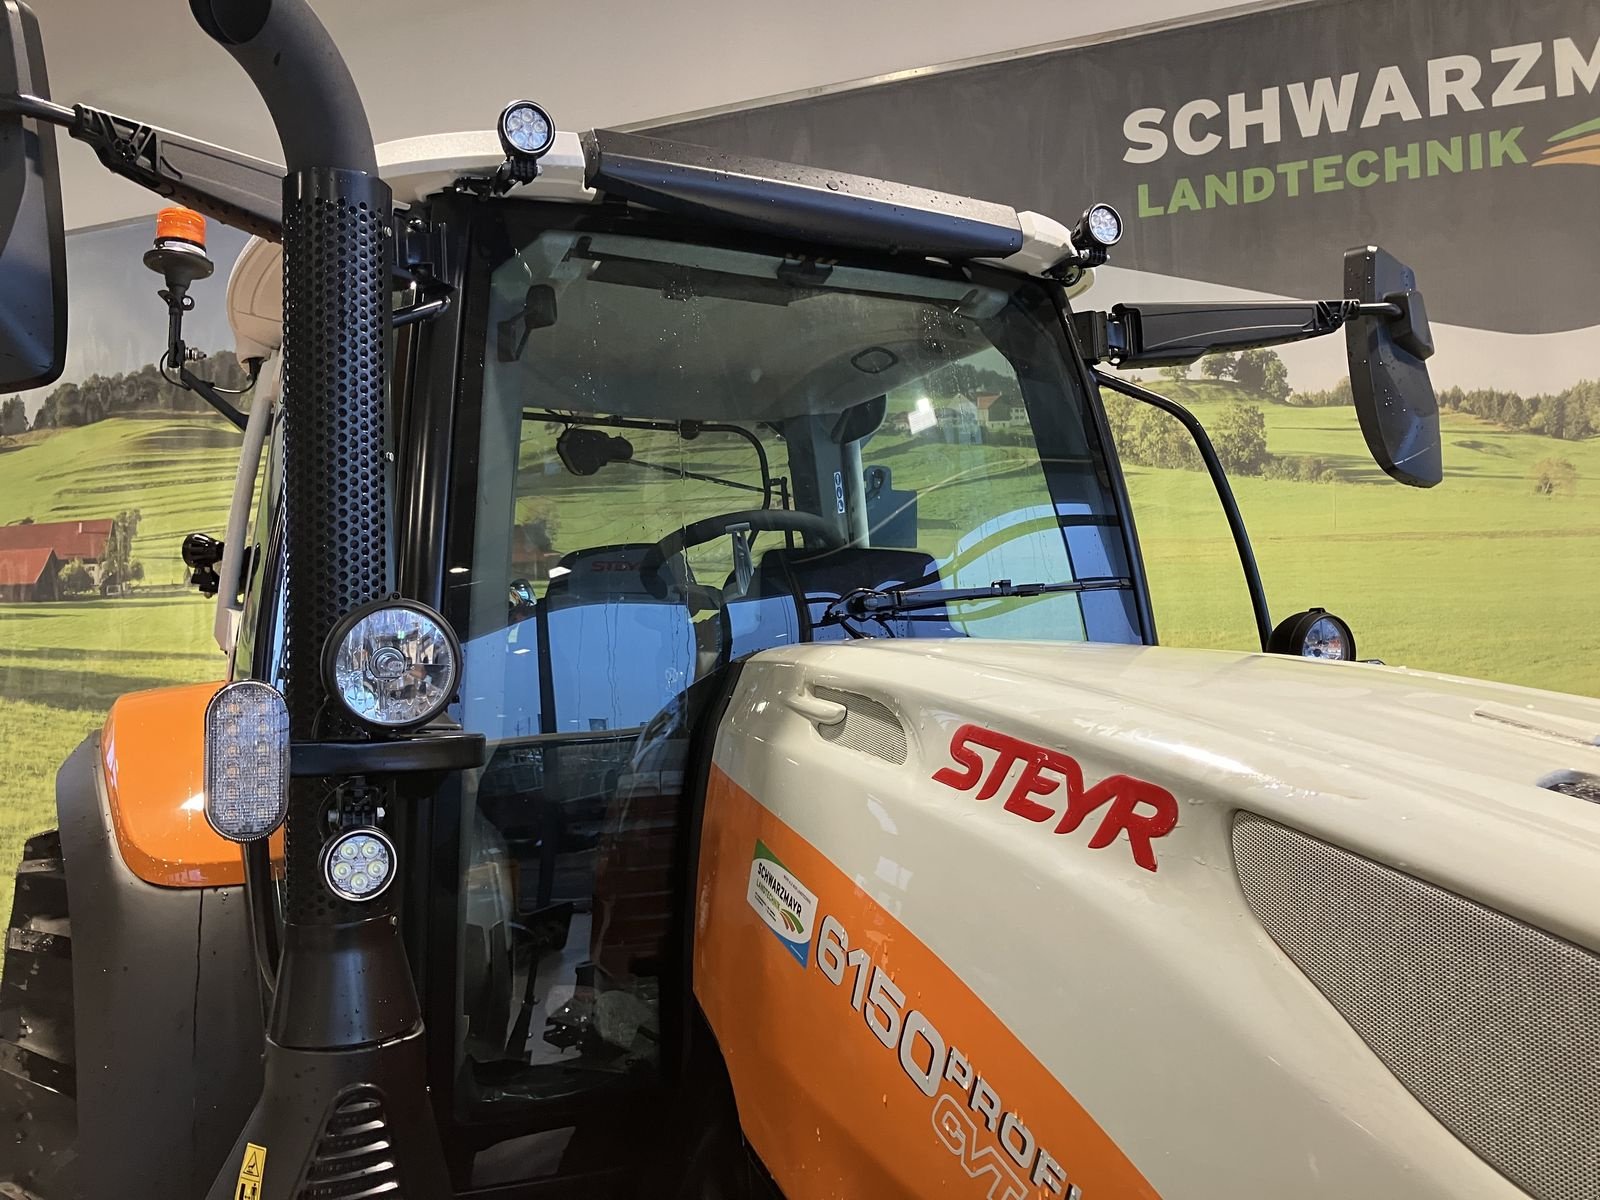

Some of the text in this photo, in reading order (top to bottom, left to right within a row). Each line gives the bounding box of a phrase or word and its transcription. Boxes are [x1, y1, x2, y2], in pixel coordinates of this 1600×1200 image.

[1123, 37, 1600, 164] SCHWARZM
[1138, 126, 1528, 218] LANDTECHNIK
[592, 560, 641, 572] STEY
[931, 723, 1179, 873] STEYR
[757, 862, 802, 918] SCHWARZMAYR
[816, 914, 946, 1097] 6150
